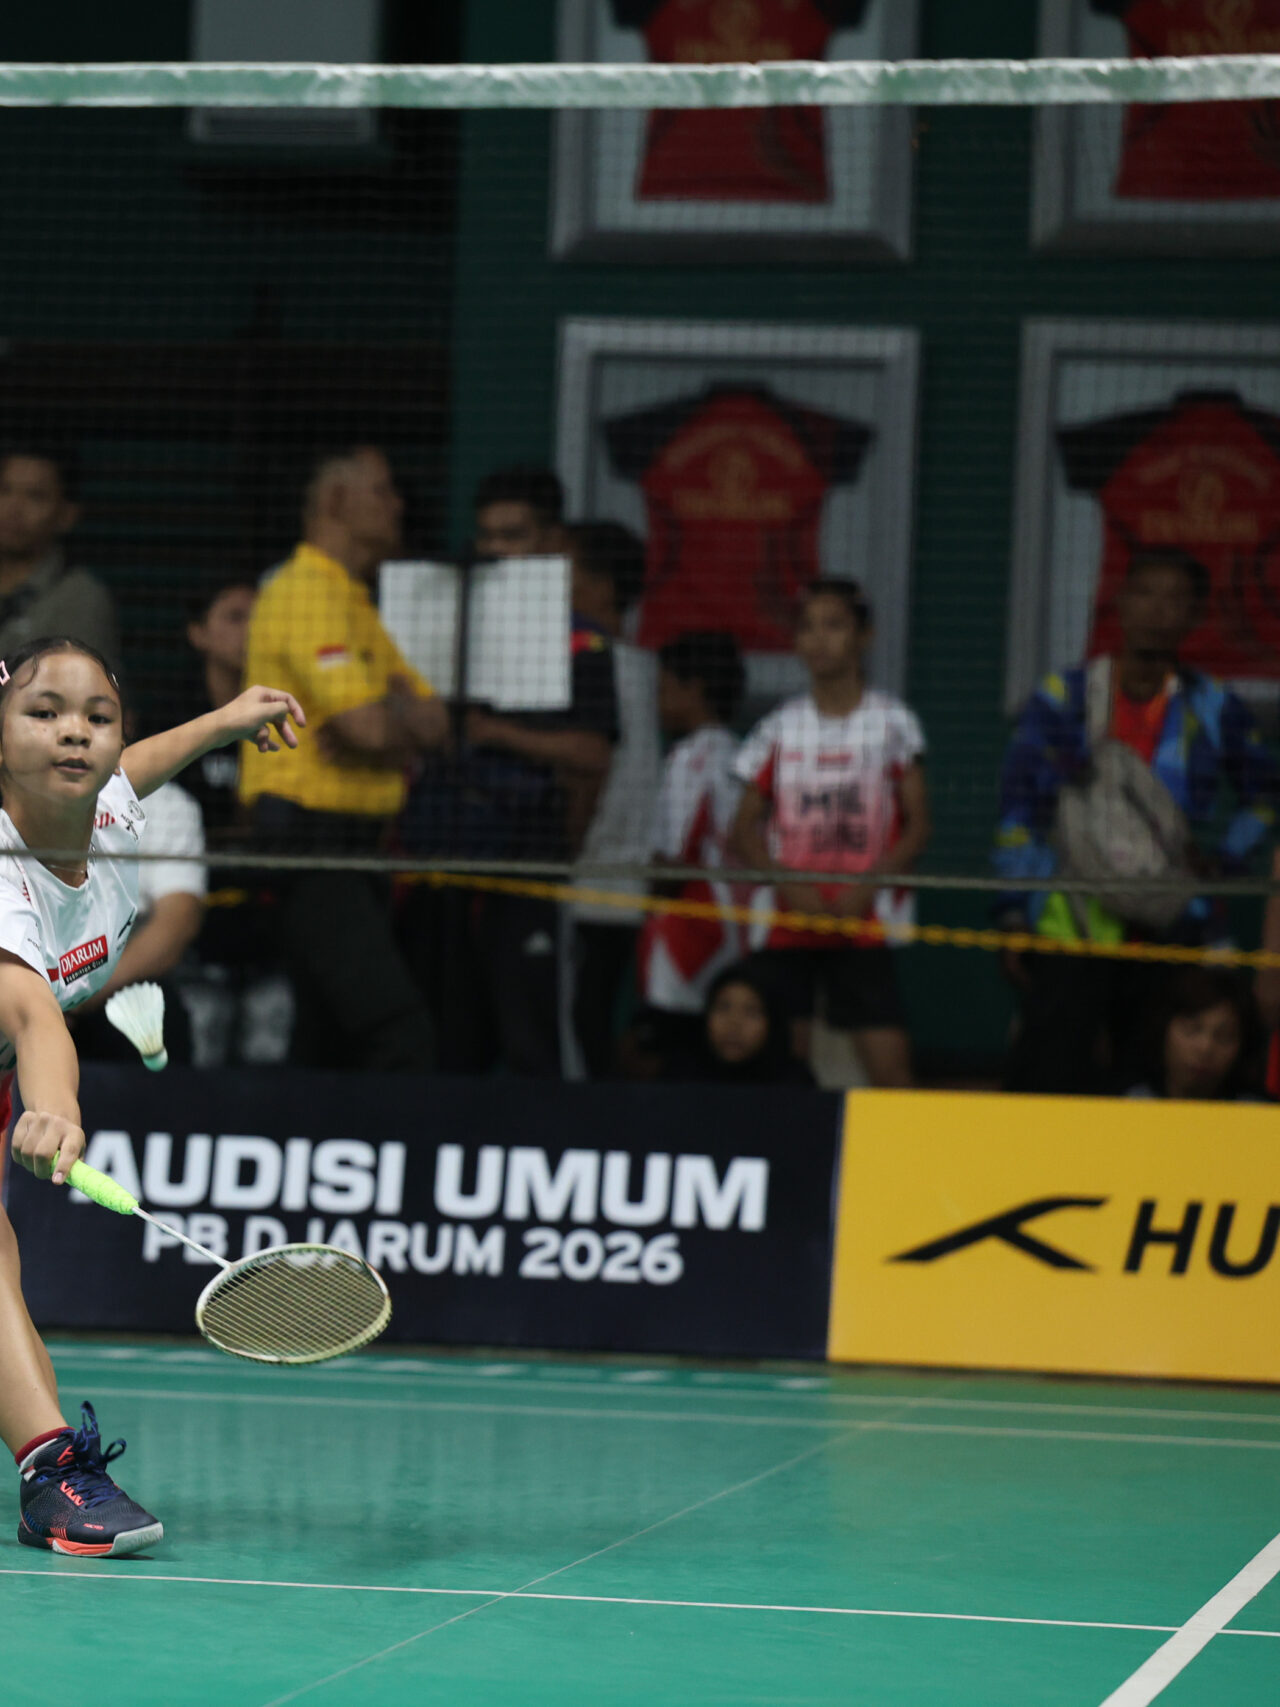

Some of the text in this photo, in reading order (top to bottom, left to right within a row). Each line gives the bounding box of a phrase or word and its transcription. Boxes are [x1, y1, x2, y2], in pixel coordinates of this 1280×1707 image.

[61, 939, 104, 974] DJARUM
[69, 1129, 770, 1233] AUDISI UMUM
[142, 1210, 686, 1285] PB DJARUM 2026
[1122, 1198, 1280, 1280] HU
